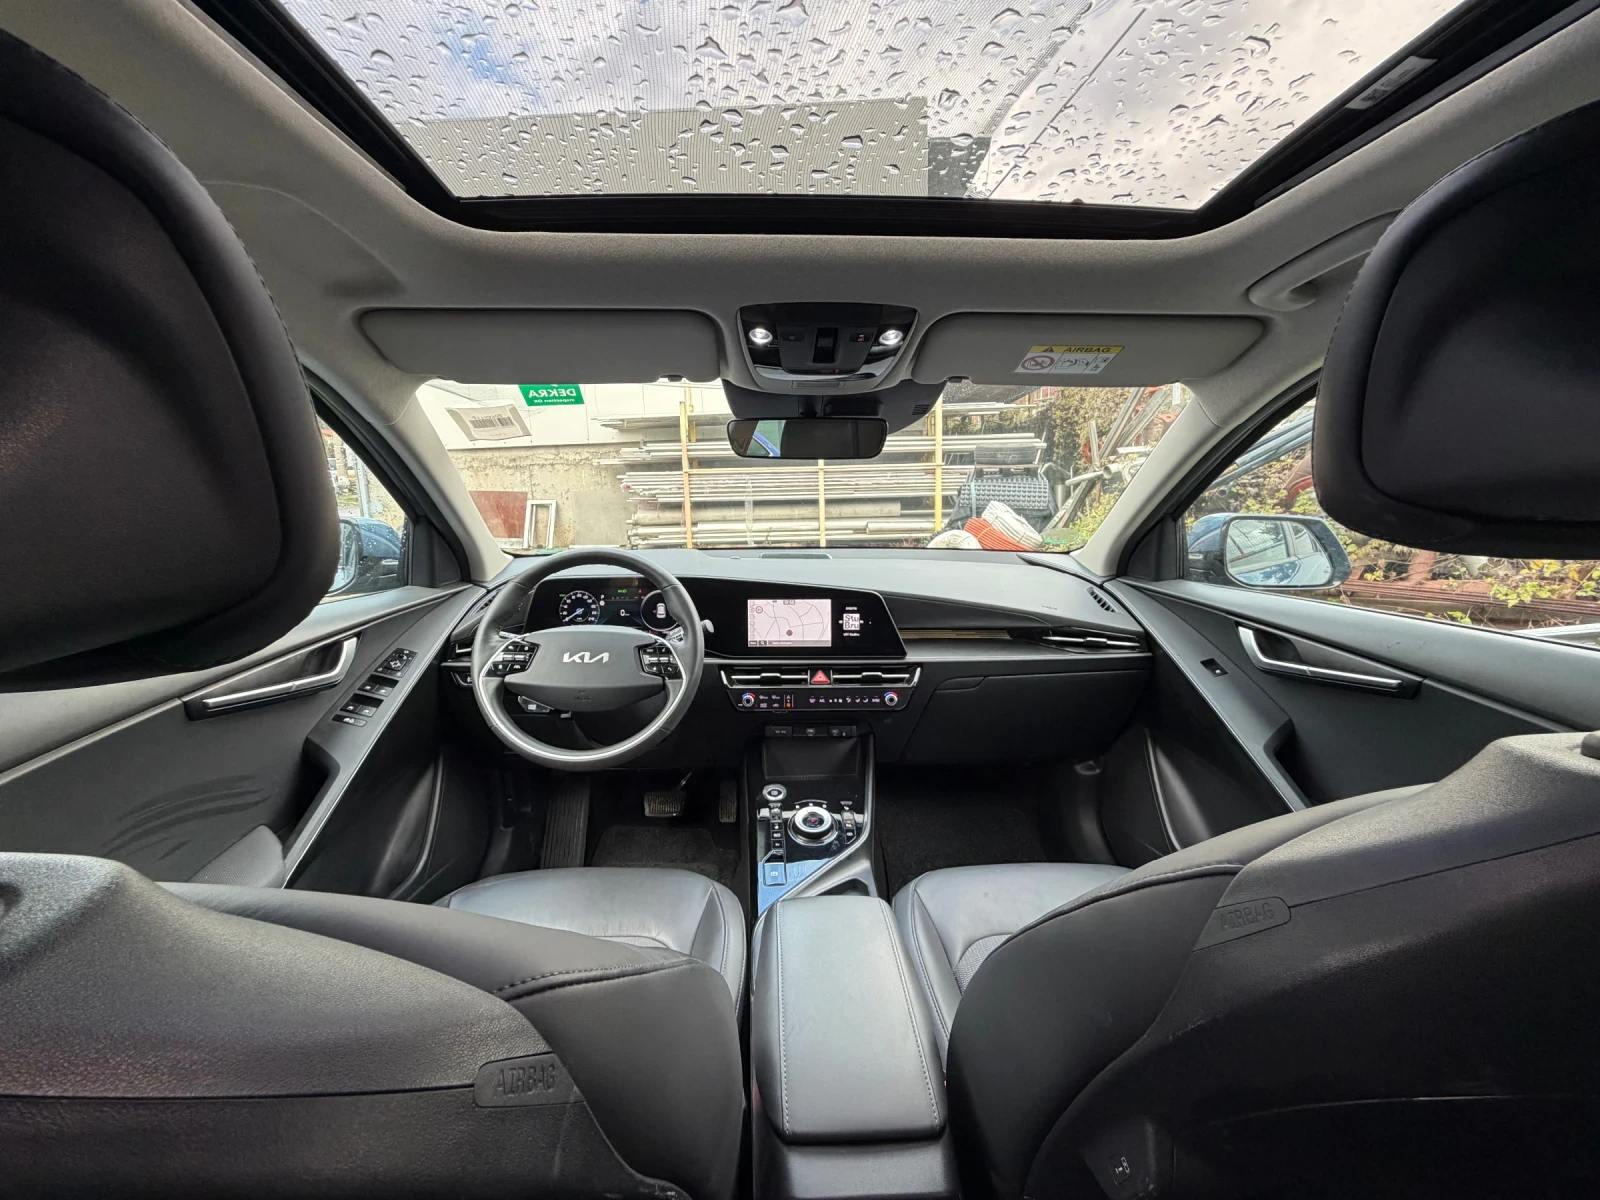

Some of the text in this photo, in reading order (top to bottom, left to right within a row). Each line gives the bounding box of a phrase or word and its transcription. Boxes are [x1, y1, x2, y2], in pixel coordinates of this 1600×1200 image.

[562, 651, 610, 664] KIA
[1220, 902, 1274, 930] AIRBAG
[494, 1063, 555, 1098] AIRBAG
